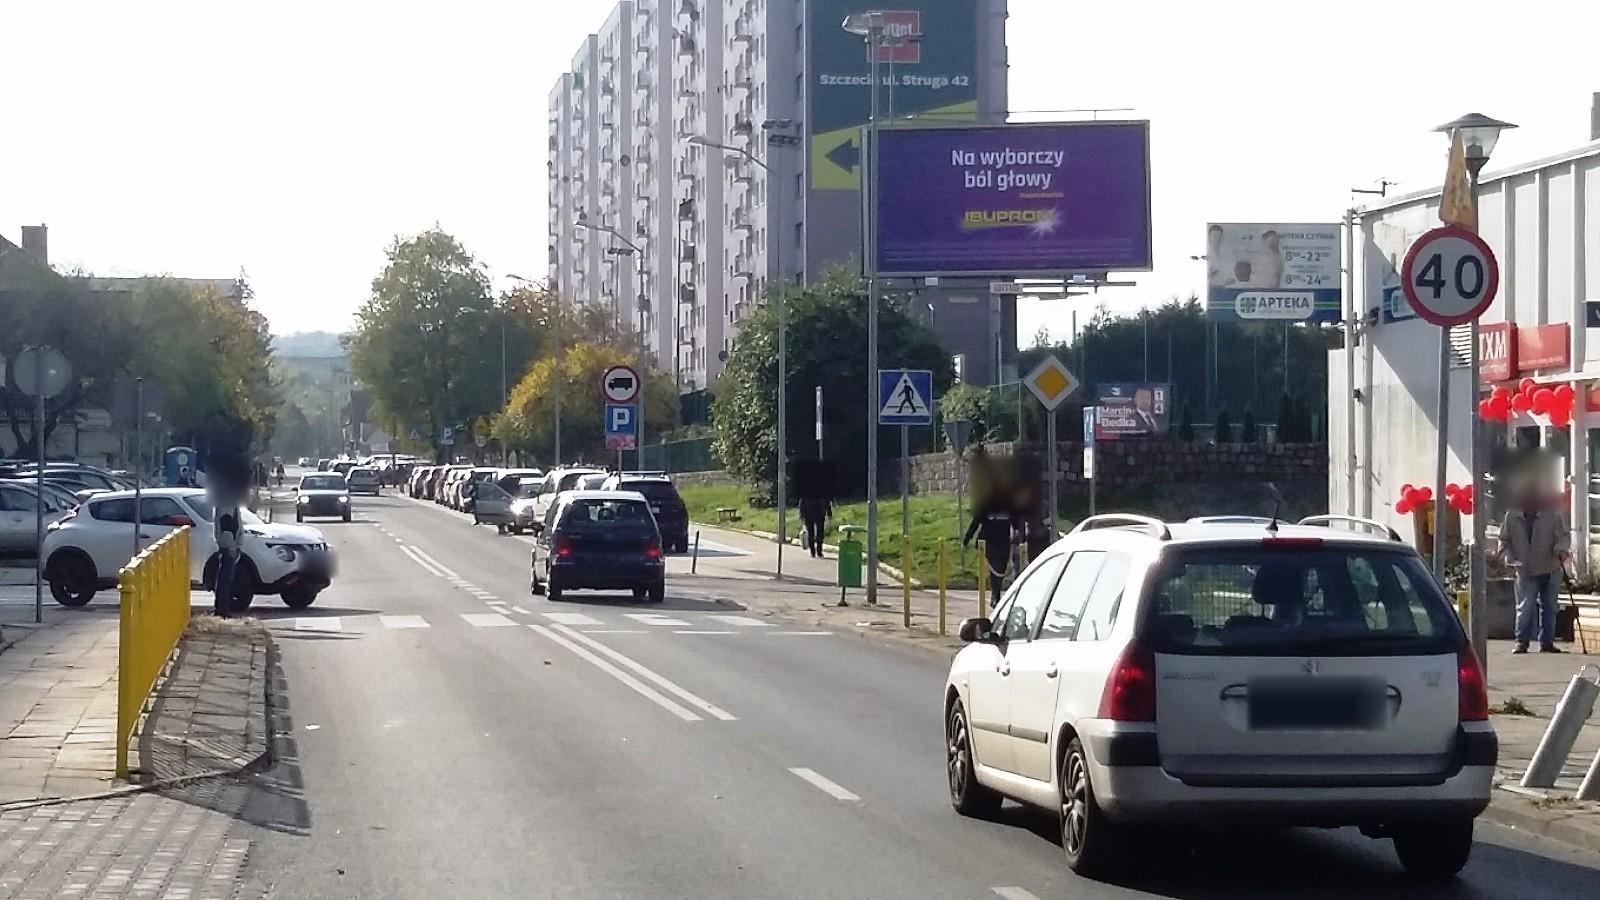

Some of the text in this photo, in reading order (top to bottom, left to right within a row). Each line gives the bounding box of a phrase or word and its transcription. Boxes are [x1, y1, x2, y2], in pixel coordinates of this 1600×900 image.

[819, 73, 880, 86] Szczeci
[903, 74, 949, 89] Struga
[951, 75, 969, 86] 42
[951, 147, 1064, 169] Na wyborczy
[965, 169, 1051, 191] ból głowy
[1415, 253, 1484, 299] 40
[1258, 297, 1310, 309] APTEKA
[1479, 330, 1506, 360] TXM
[612, 408, 630, 431] P
[443, 429, 452, 439] P
